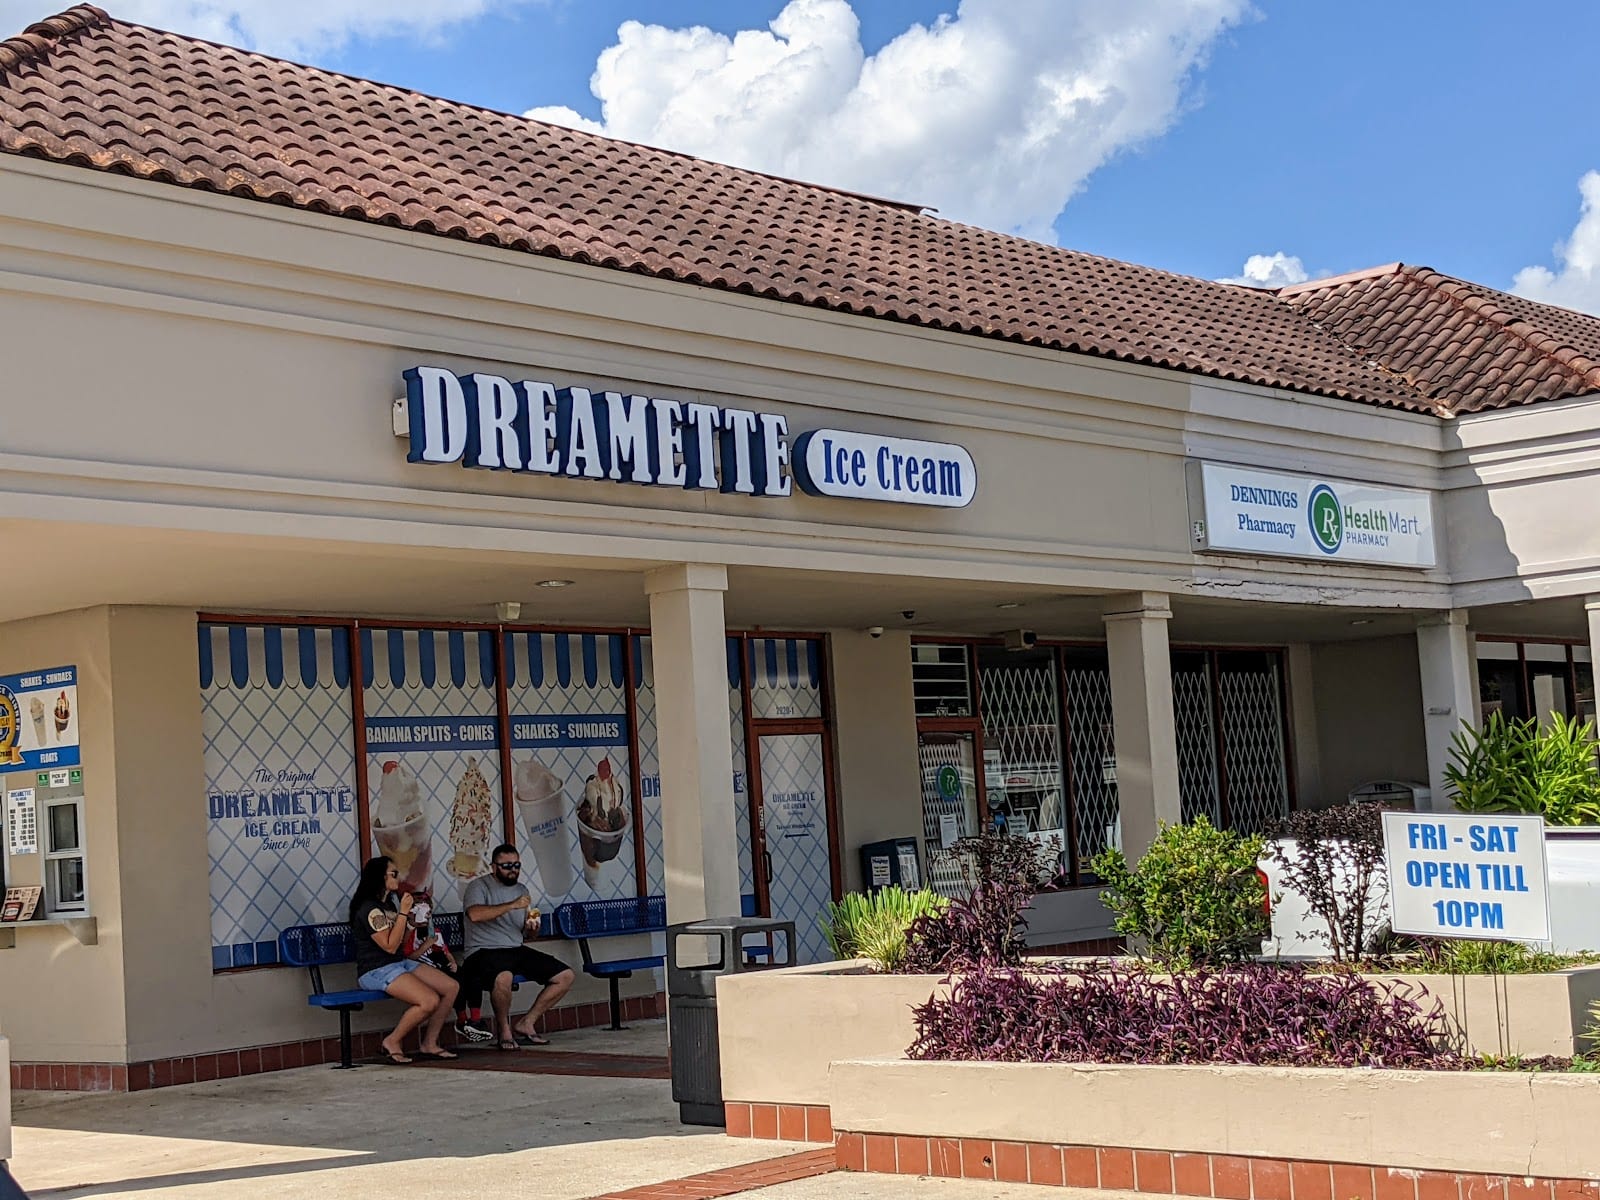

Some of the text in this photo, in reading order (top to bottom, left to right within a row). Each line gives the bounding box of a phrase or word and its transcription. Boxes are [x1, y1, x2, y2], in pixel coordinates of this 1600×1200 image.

[416, 366, 962, 497] DREAMETTE Ice Cream
[1231, 484, 1298, 509] DENNINGS
[1237, 513, 1296, 539] Pharmacy
[1344, 505, 1388, 532] Health
[1346, 531, 1389, 547] PHARMACY
[20, 676, 42, 688] SHAKES
[46, 671, 73, 684] SUNDAES
[366, 726, 412, 743] BANANA
[413, 725, 451, 742] SPLITS
[459, 725, 494, 741] CONES
[513, 724, 559, 739] SHAKES
[568, 723, 619, 738] SUNDAES
[40, 752, 58, 764] FLOATS
[255, 768, 316, 788] The Original
[209, 786, 352, 819] DREAMETTE
[245, 818, 321, 838] ICE CREAM
[1407, 823, 1448, 850] FRI
[1469, 824, 1519, 853] SAT
[263, 838, 311, 851] Since 1948
[1406, 860, 1529, 892] OPEN TILL
[1433, 899, 1504, 930] 10PM
